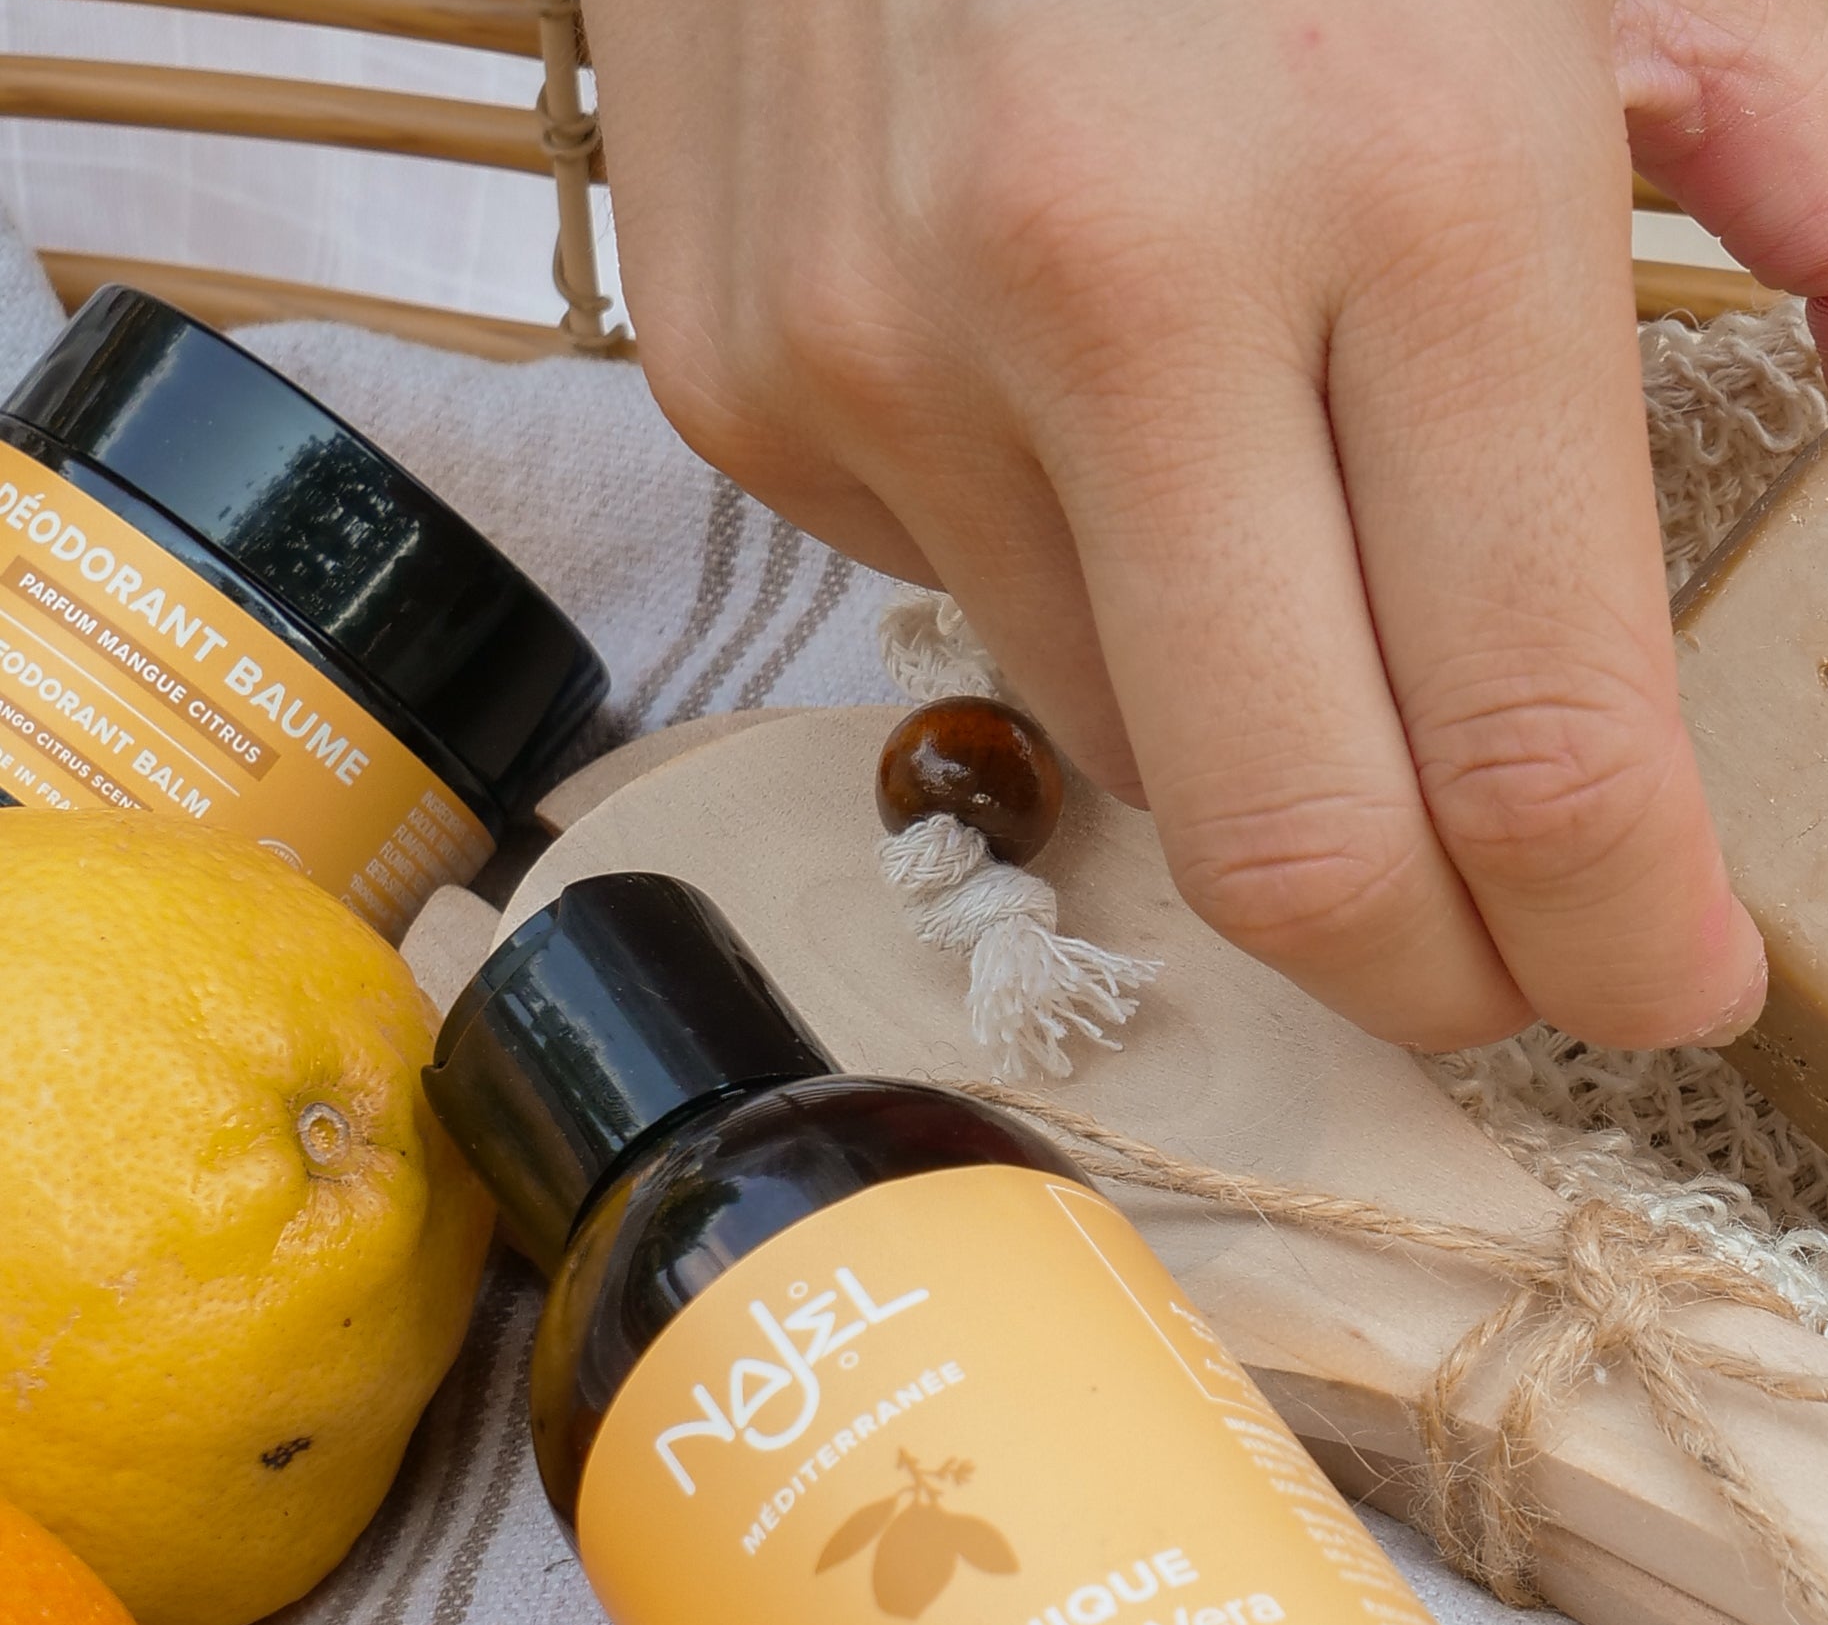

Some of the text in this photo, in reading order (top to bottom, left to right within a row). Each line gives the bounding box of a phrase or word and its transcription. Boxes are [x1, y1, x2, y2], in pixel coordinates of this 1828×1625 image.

[0, 482, 371, 786] DÉODORANT BAUME
[19, 573, 262, 764] PARFUM MANGUE CITRUS
[14, 764, 37, 786] IN
[36, 733, 92, 778] CITRUS
[132, 749, 212, 818] BALM
[742, 1360, 966, 1555] MÉDITERRANÉE
